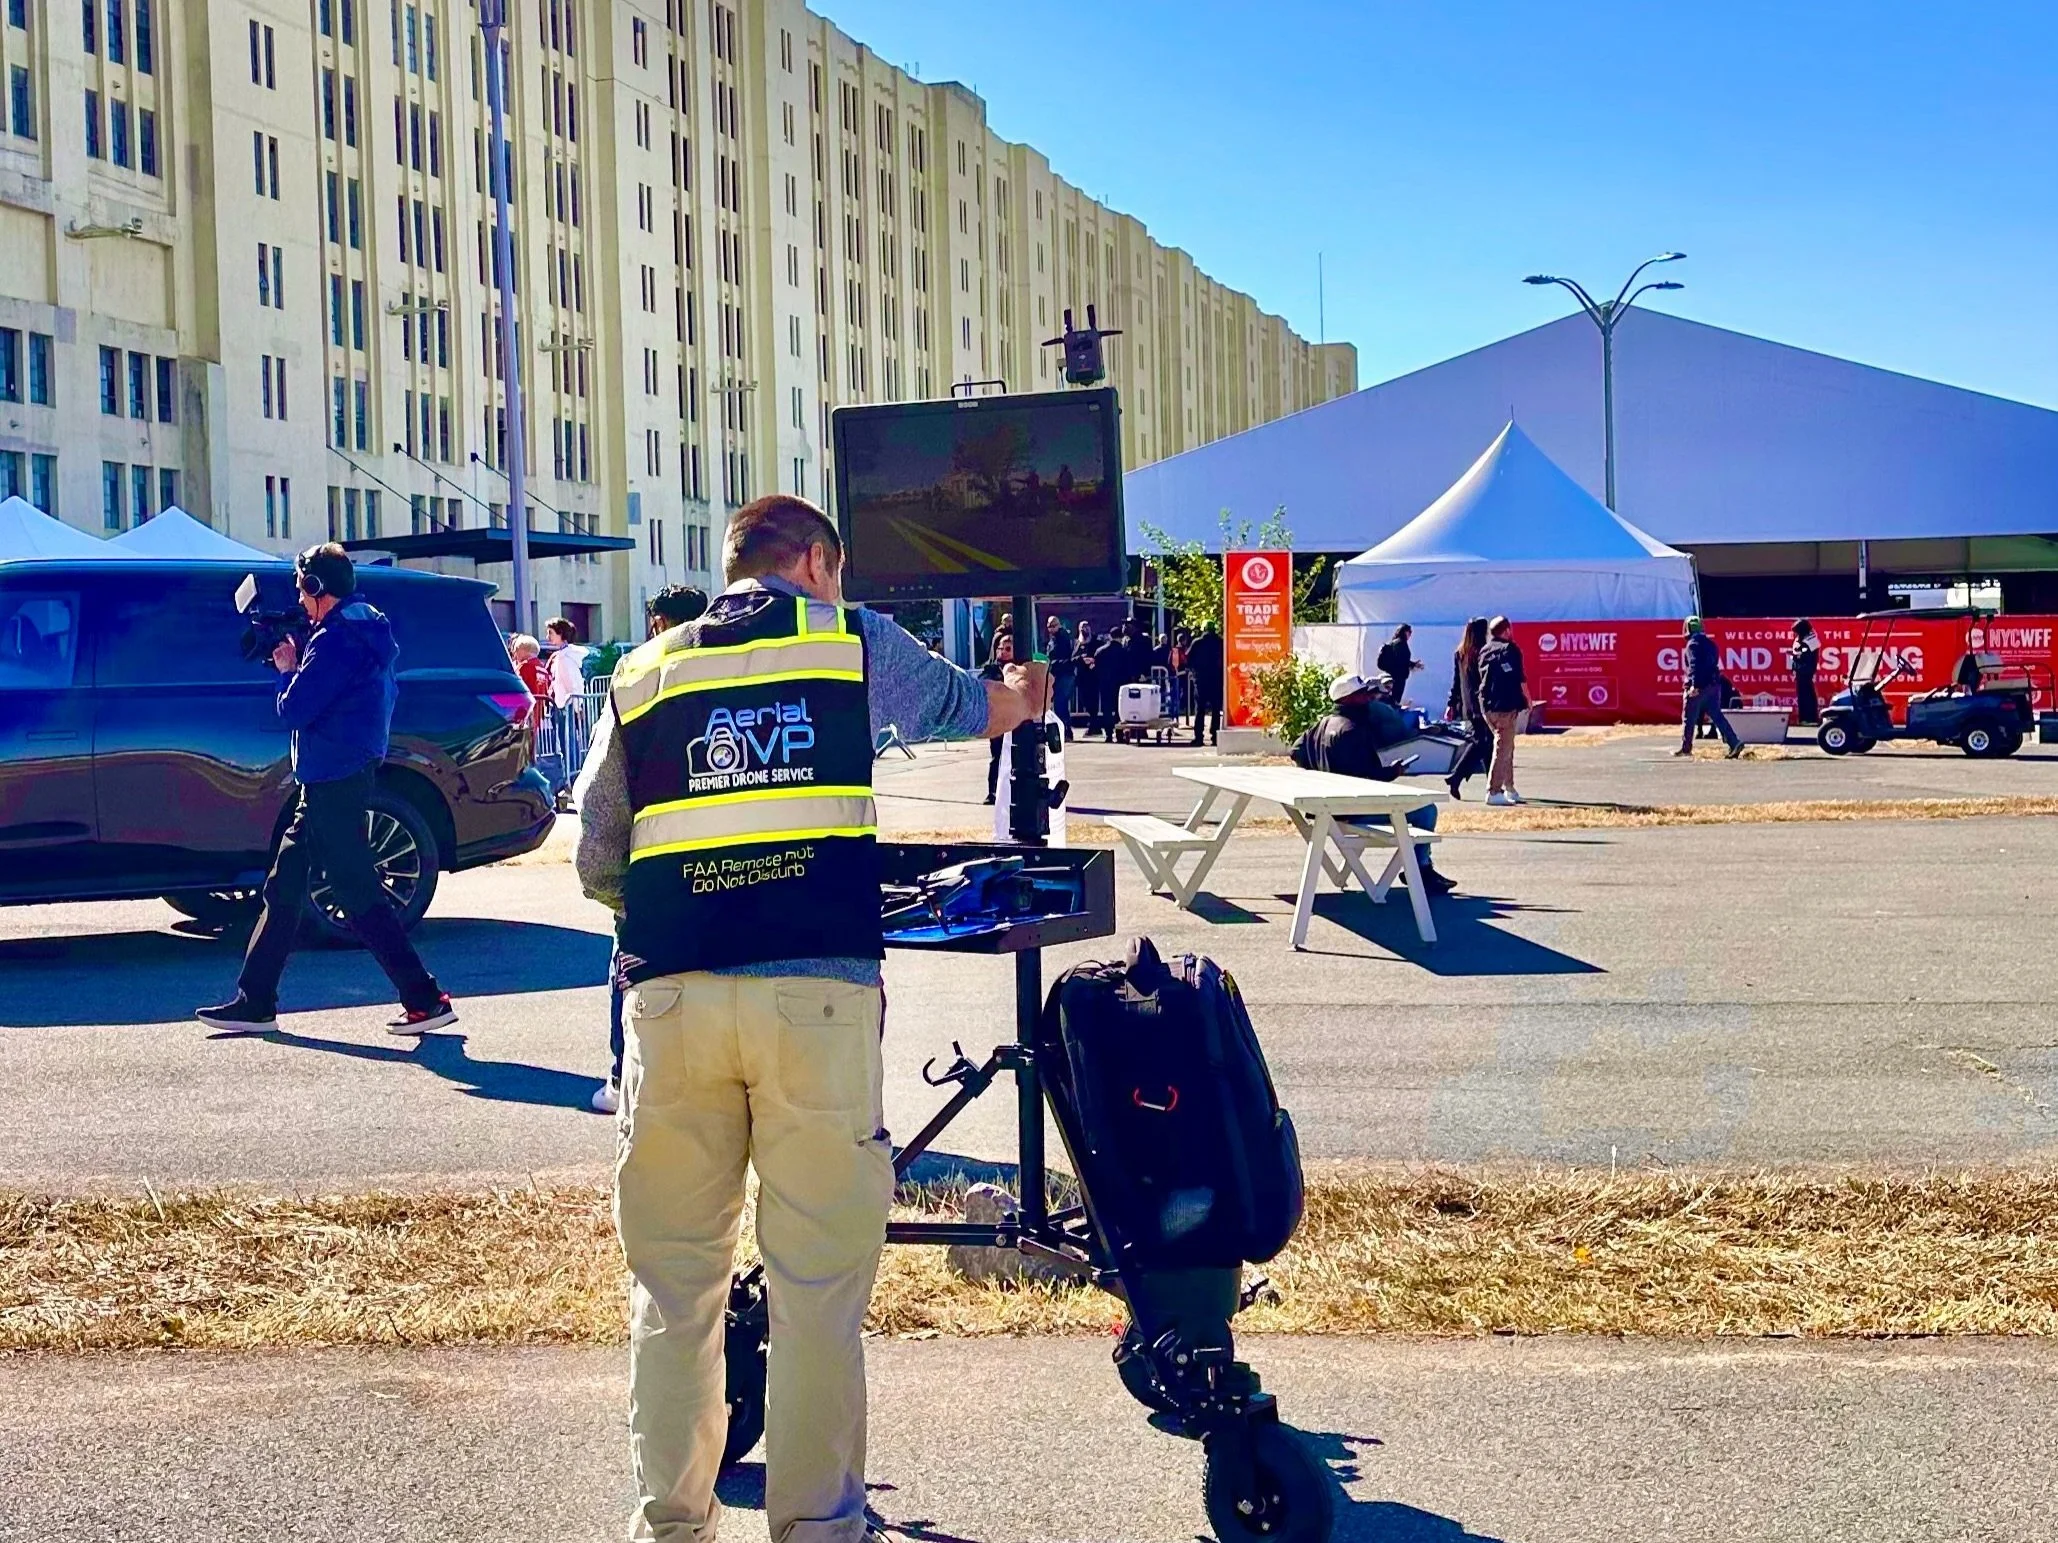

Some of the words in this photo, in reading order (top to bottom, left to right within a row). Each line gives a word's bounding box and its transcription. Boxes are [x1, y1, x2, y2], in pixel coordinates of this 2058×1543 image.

[1236, 604, 1280, 615] TRADE
[1245, 615, 1271, 625] DAY
[1560, 632, 1617, 651] NYCWFF
[1725, 631, 1795, 640] WELCOME
[1824, 631, 1851, 639] THE
[1989, 628, 2053, 648] NYCWFF
[1657, 647, 1773, 671] GND
[1779, 646, 1924, 670] TSTING
[1733, 674, 1797, 683] CULINARY
[704, 697, 813, 744] Aerial
[745, 725, 815, 764] VP
[688, 778, 731, 792] PREMIER
[732, 769, 769, 787] DRONE
[771, 767, 814, 783] SERVICE
[683, 861, 719, 878] FAA
[721, 854, 782, 873] Remote
[692, 879, 715, 893] Do
[716, 874, 746, 890] Not
